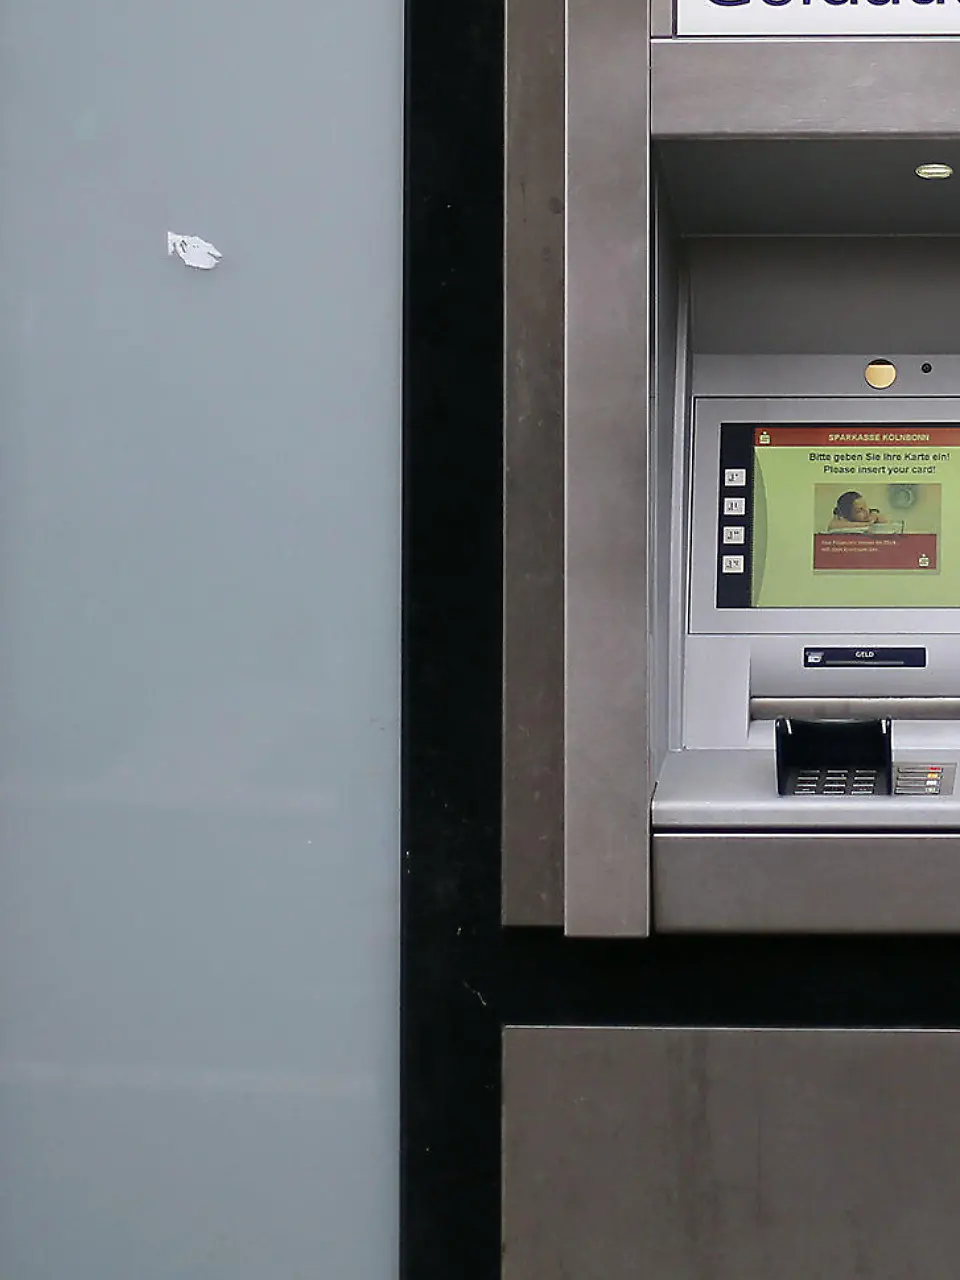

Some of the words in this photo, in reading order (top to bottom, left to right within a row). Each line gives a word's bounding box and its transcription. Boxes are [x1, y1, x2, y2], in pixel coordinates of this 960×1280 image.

[828, 433, 880, 442] SPARKASSE
[809, 452, 832, 461] Bitte
[833, 453, 863, 464] geben
[865, 452, 881, 461] Sie
[883, 452, 902, 461] Ihre
[904, 452, 930, 461] Karte
[932, 452, 950, 461] ein!
[823, 465, 856, 474] Please
[857, 466, 886, 474] insert
[888, 466, 909, 476] your
[911, 465, 936, 474] card!
